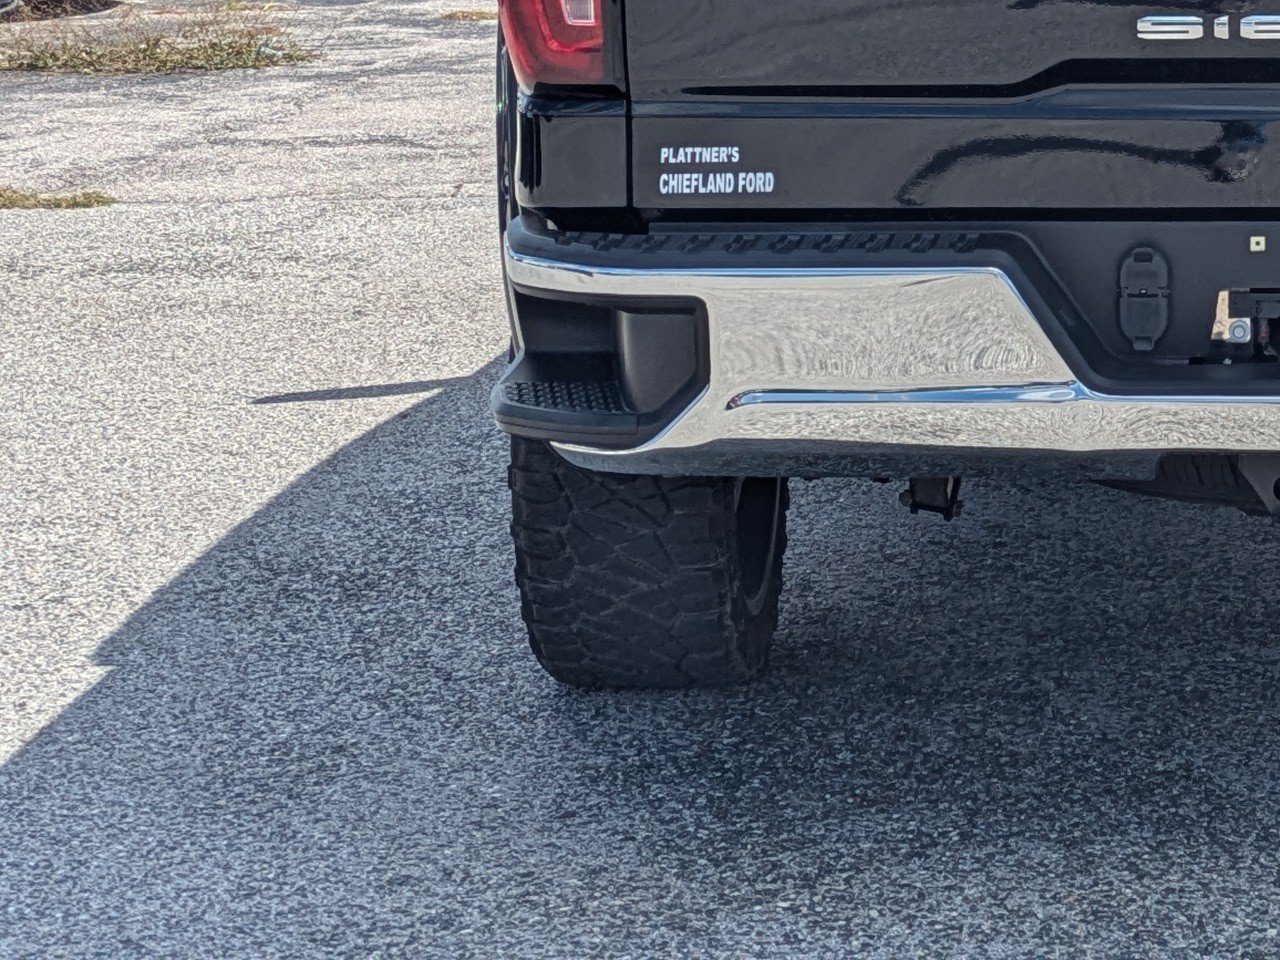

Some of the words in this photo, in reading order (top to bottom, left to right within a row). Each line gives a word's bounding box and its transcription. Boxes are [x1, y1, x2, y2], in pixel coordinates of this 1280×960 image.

[660, 146, 740, 164] PLATTNER'S
[659, 172, 735, 194] CHIEFLAND
[737, 171, 775, 193] FORD
